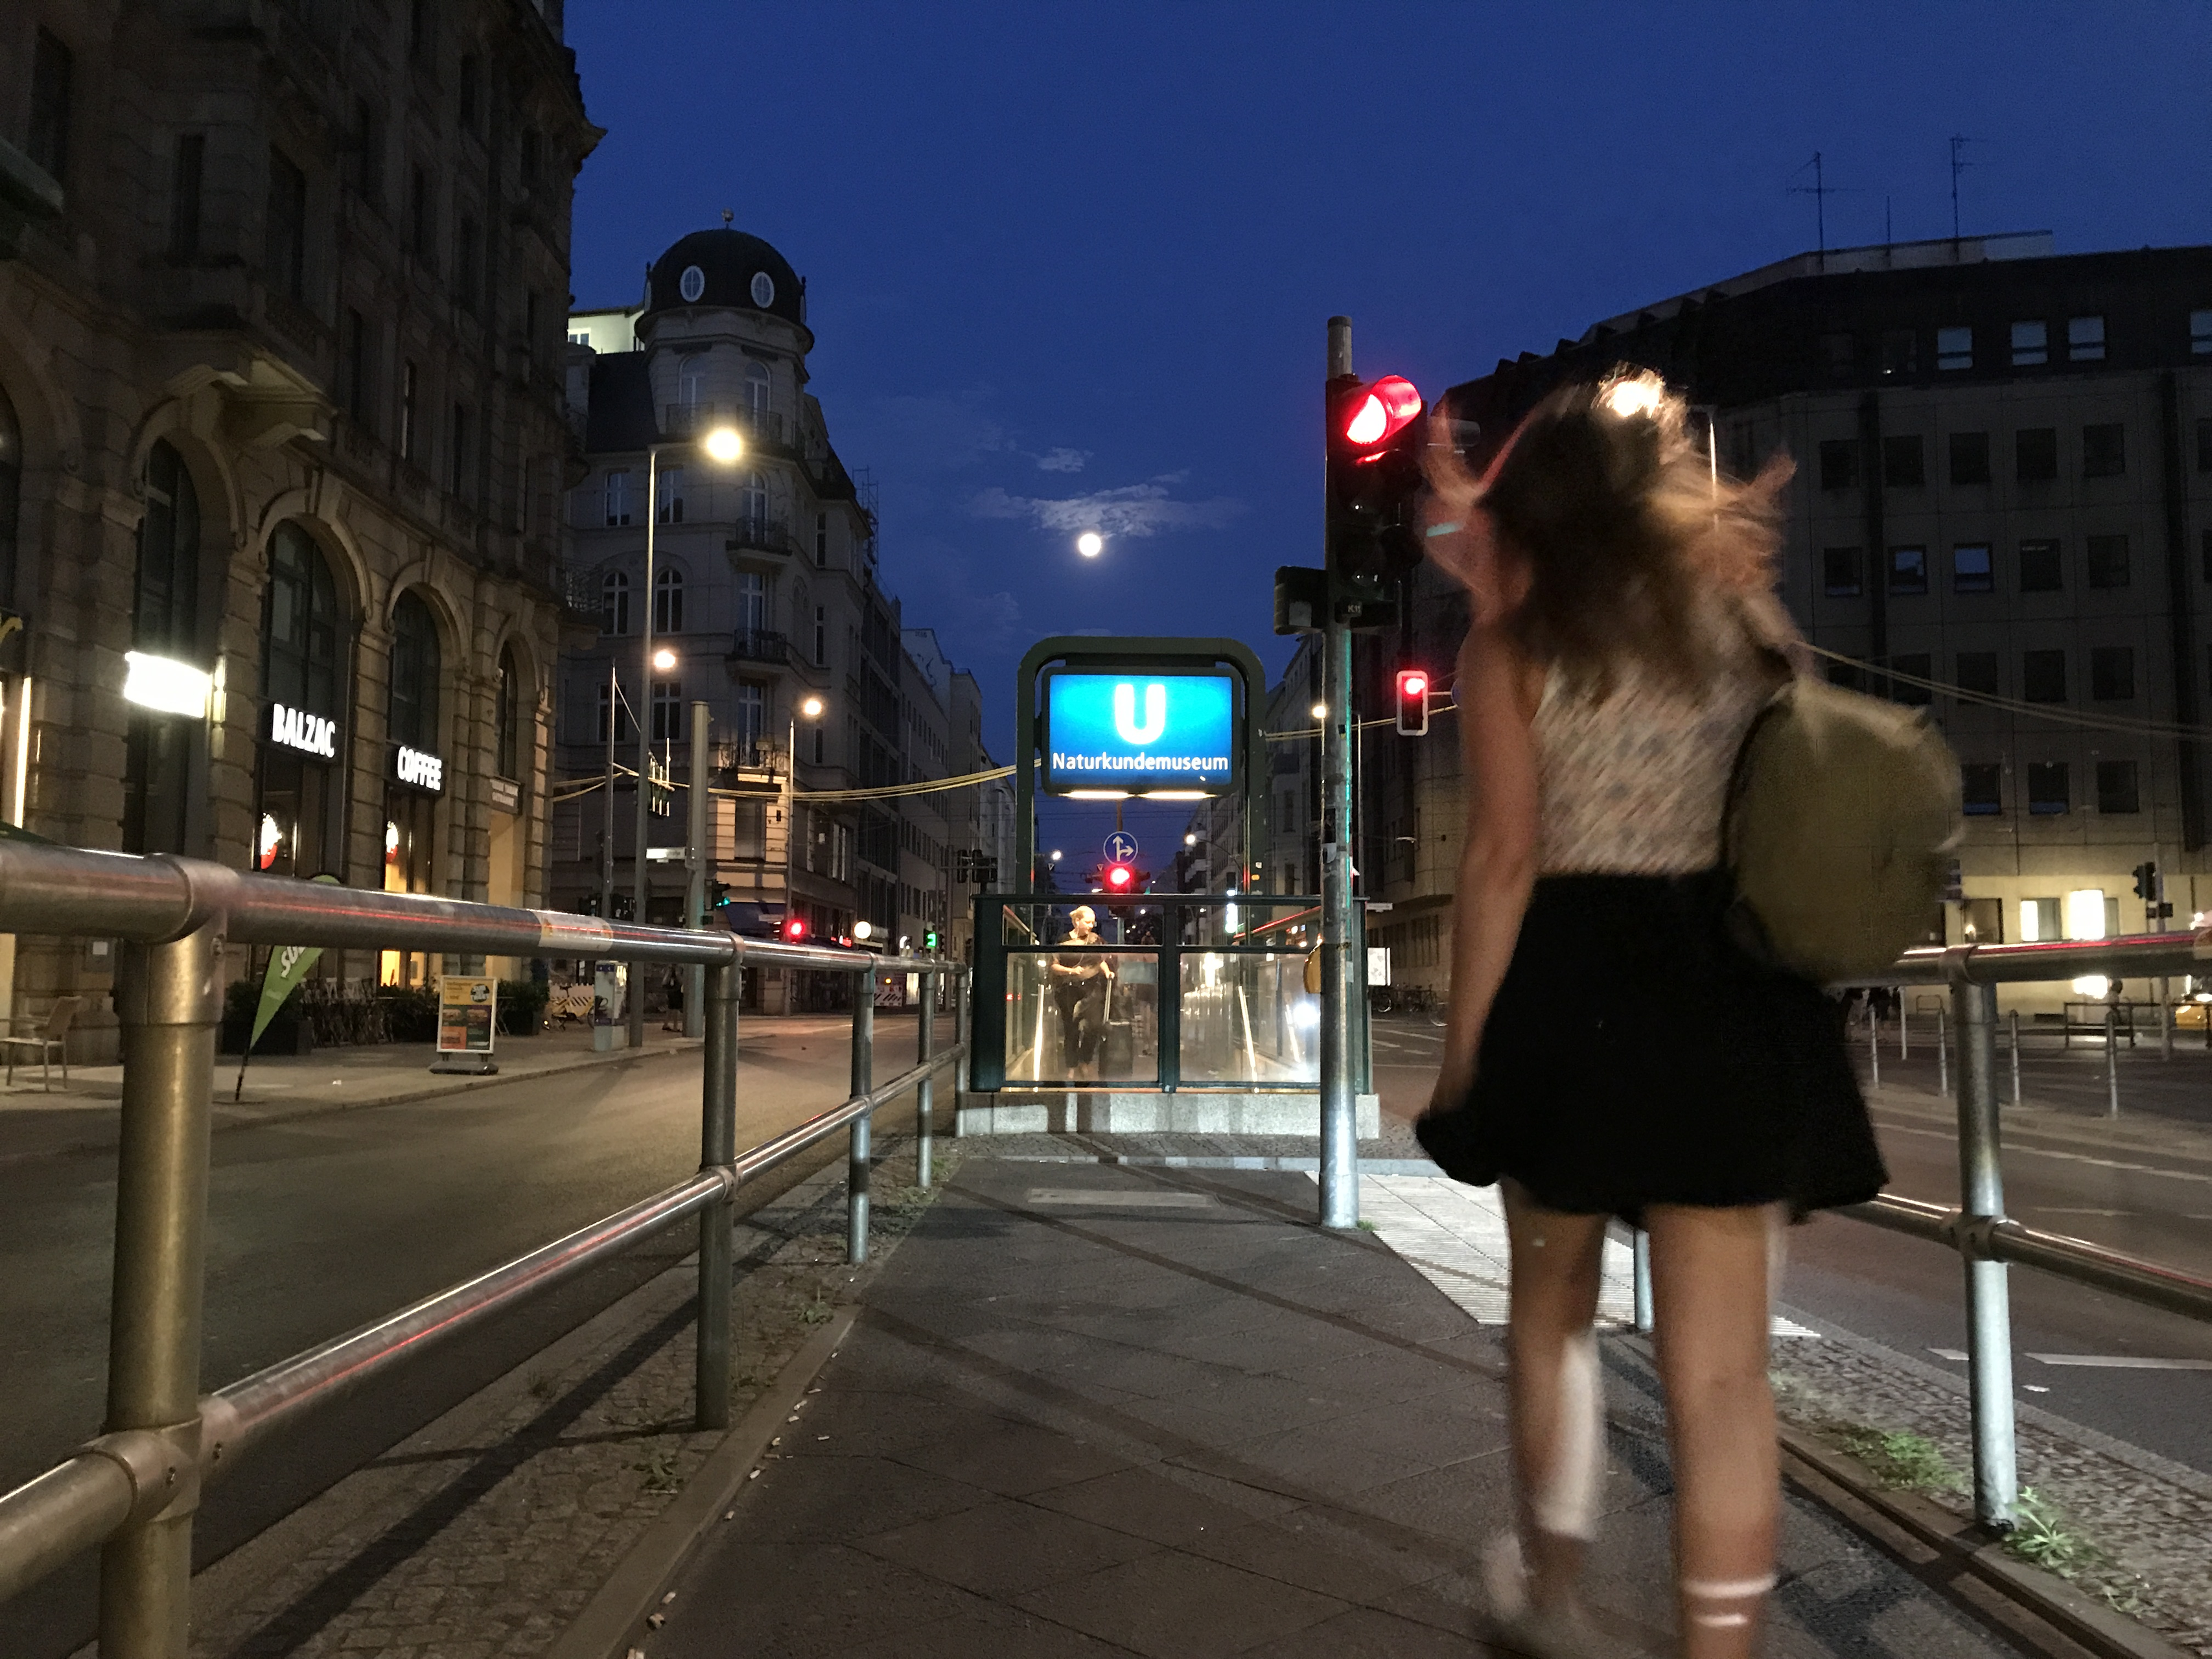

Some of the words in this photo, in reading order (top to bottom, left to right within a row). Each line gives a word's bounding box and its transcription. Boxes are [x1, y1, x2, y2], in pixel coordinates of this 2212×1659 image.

[272, 703, 335, 758] BALZAC
[1115, 684, 1166, 745] U
[397, 746, 442, 791] COFFEE
[1052, 752, 1228, 771] Naturkundemuseum
